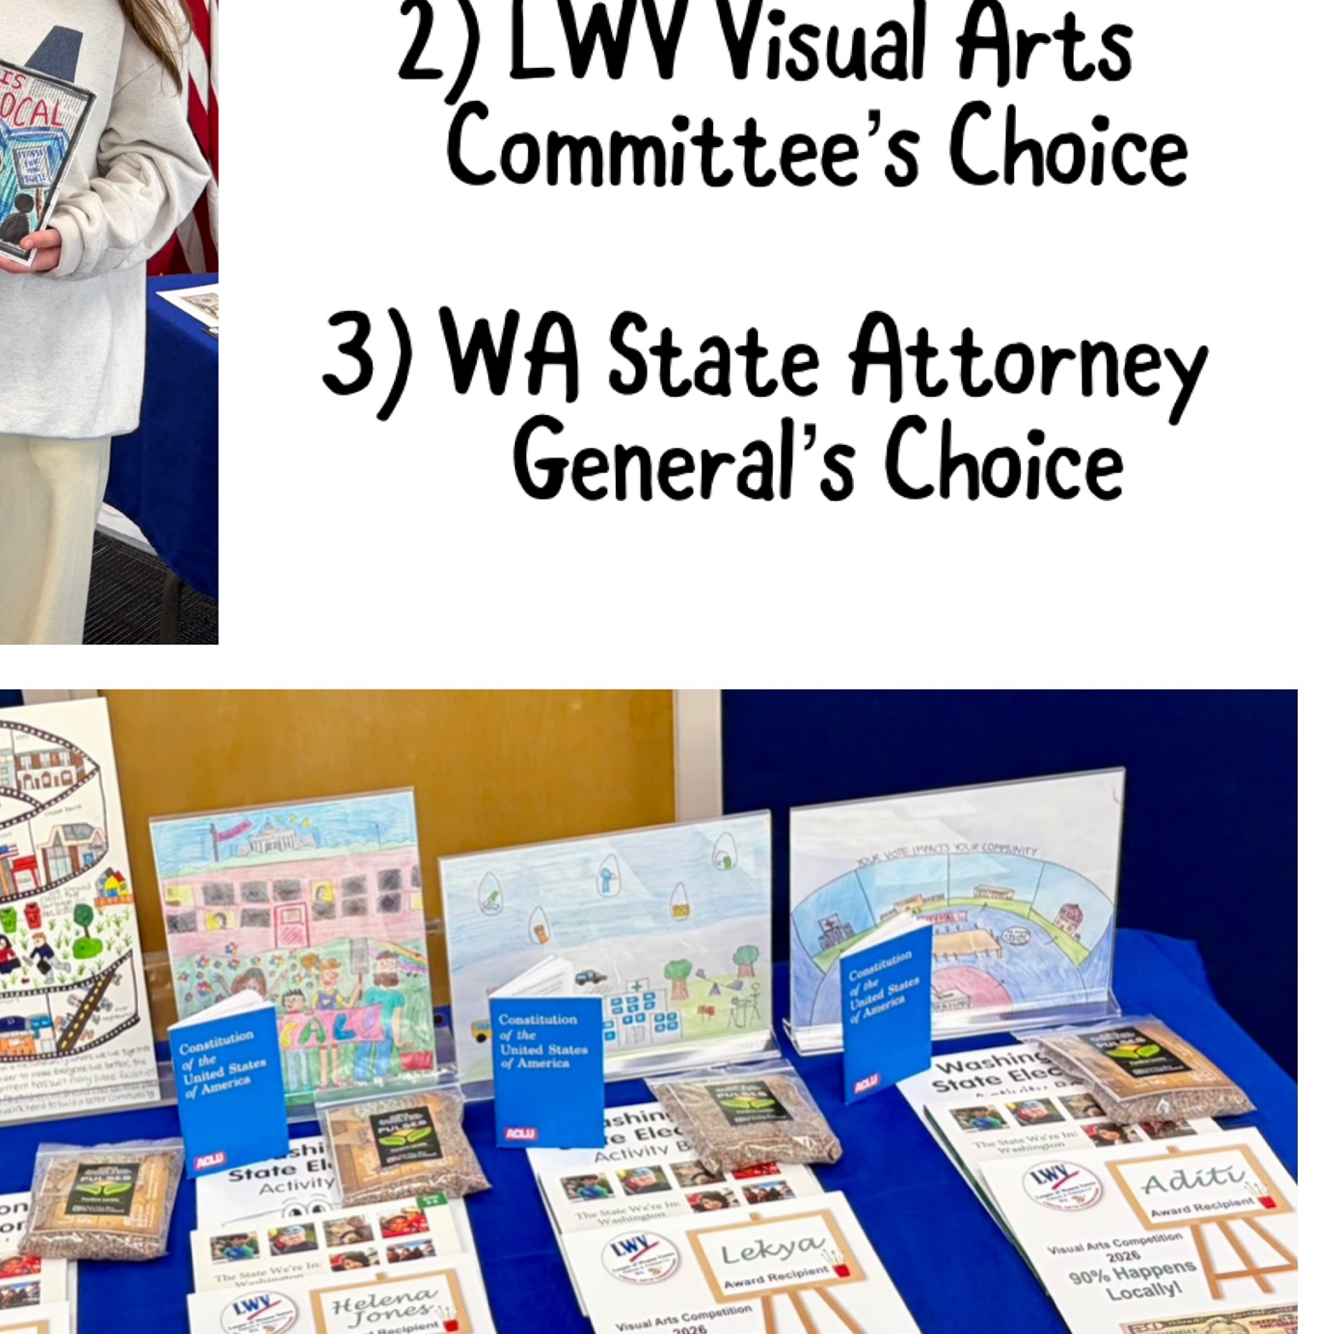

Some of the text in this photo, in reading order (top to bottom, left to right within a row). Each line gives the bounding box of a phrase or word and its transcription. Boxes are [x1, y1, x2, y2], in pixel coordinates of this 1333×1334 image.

[0, 71, 26, 89] IS
[499, 1014, 578, 1026] Constitution
[500, 1029, 536, 1041] of the
[500, 1044, 589, 1057] United States
[501, 1057, 570, 1070] of America
[505, 1128, 536, 1141] ACLU
